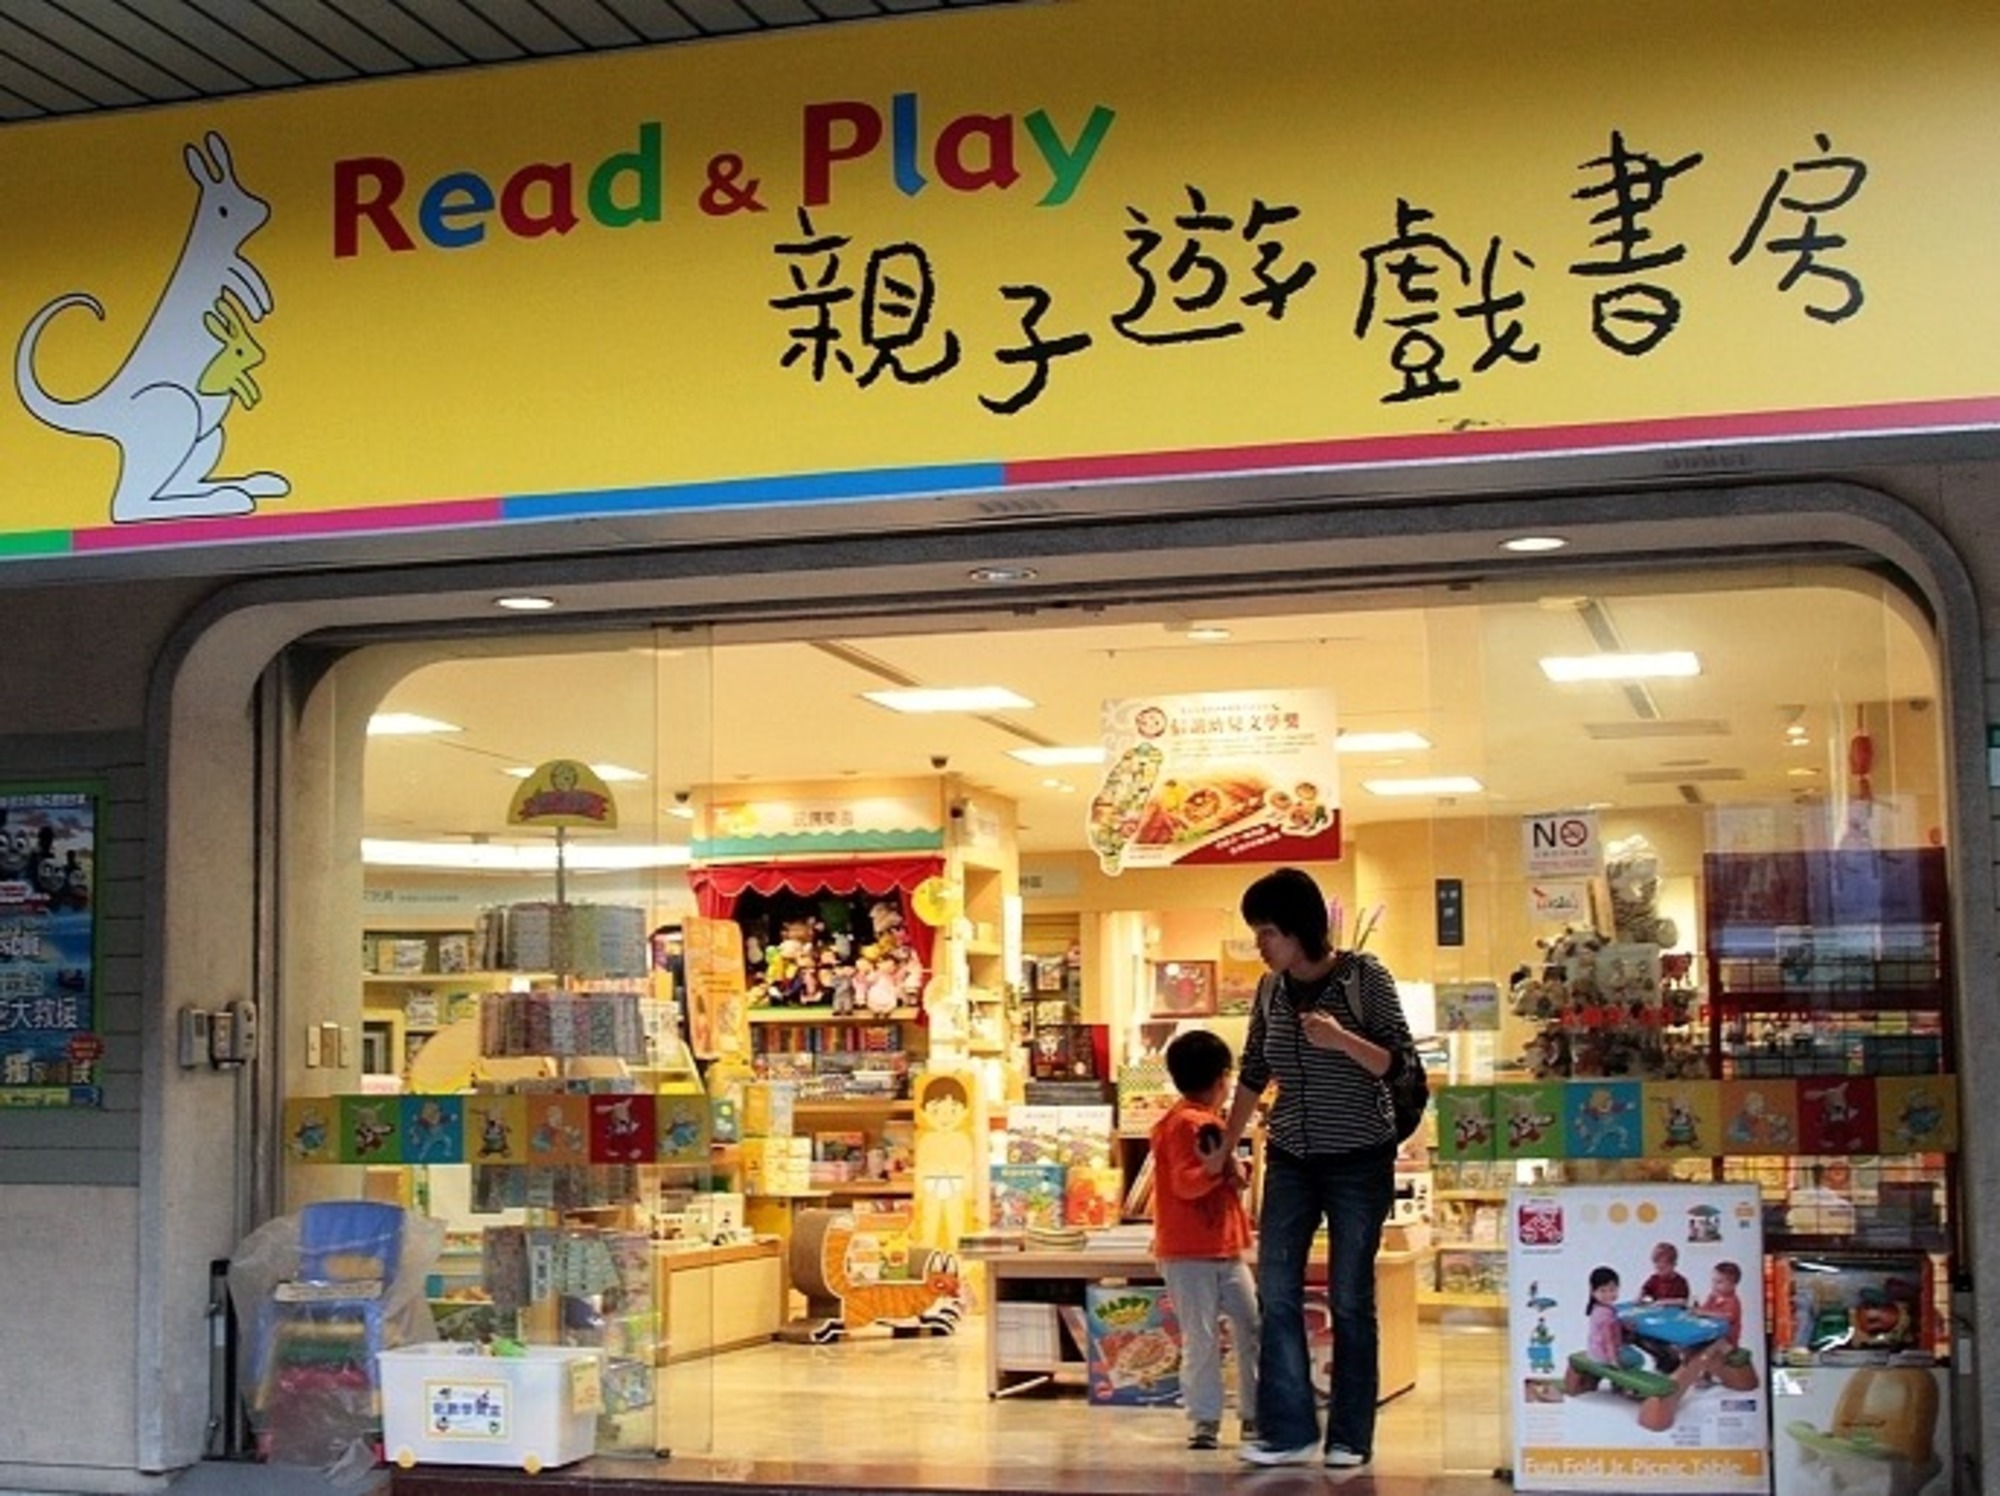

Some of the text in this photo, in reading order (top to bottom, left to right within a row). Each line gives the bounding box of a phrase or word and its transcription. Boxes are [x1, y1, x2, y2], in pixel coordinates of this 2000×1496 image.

[333, 92, 1116, 258] Read & Play
[768, 130, 1868, 414] 親子遊戲書房
[1525, 1458, 1558, 1477] Fun
[1563, 1457, 1603, 1477] Fold
[1632, 1457, 1687, 1477] Picnic
[1692, 1457, 1743, 1477] Table
